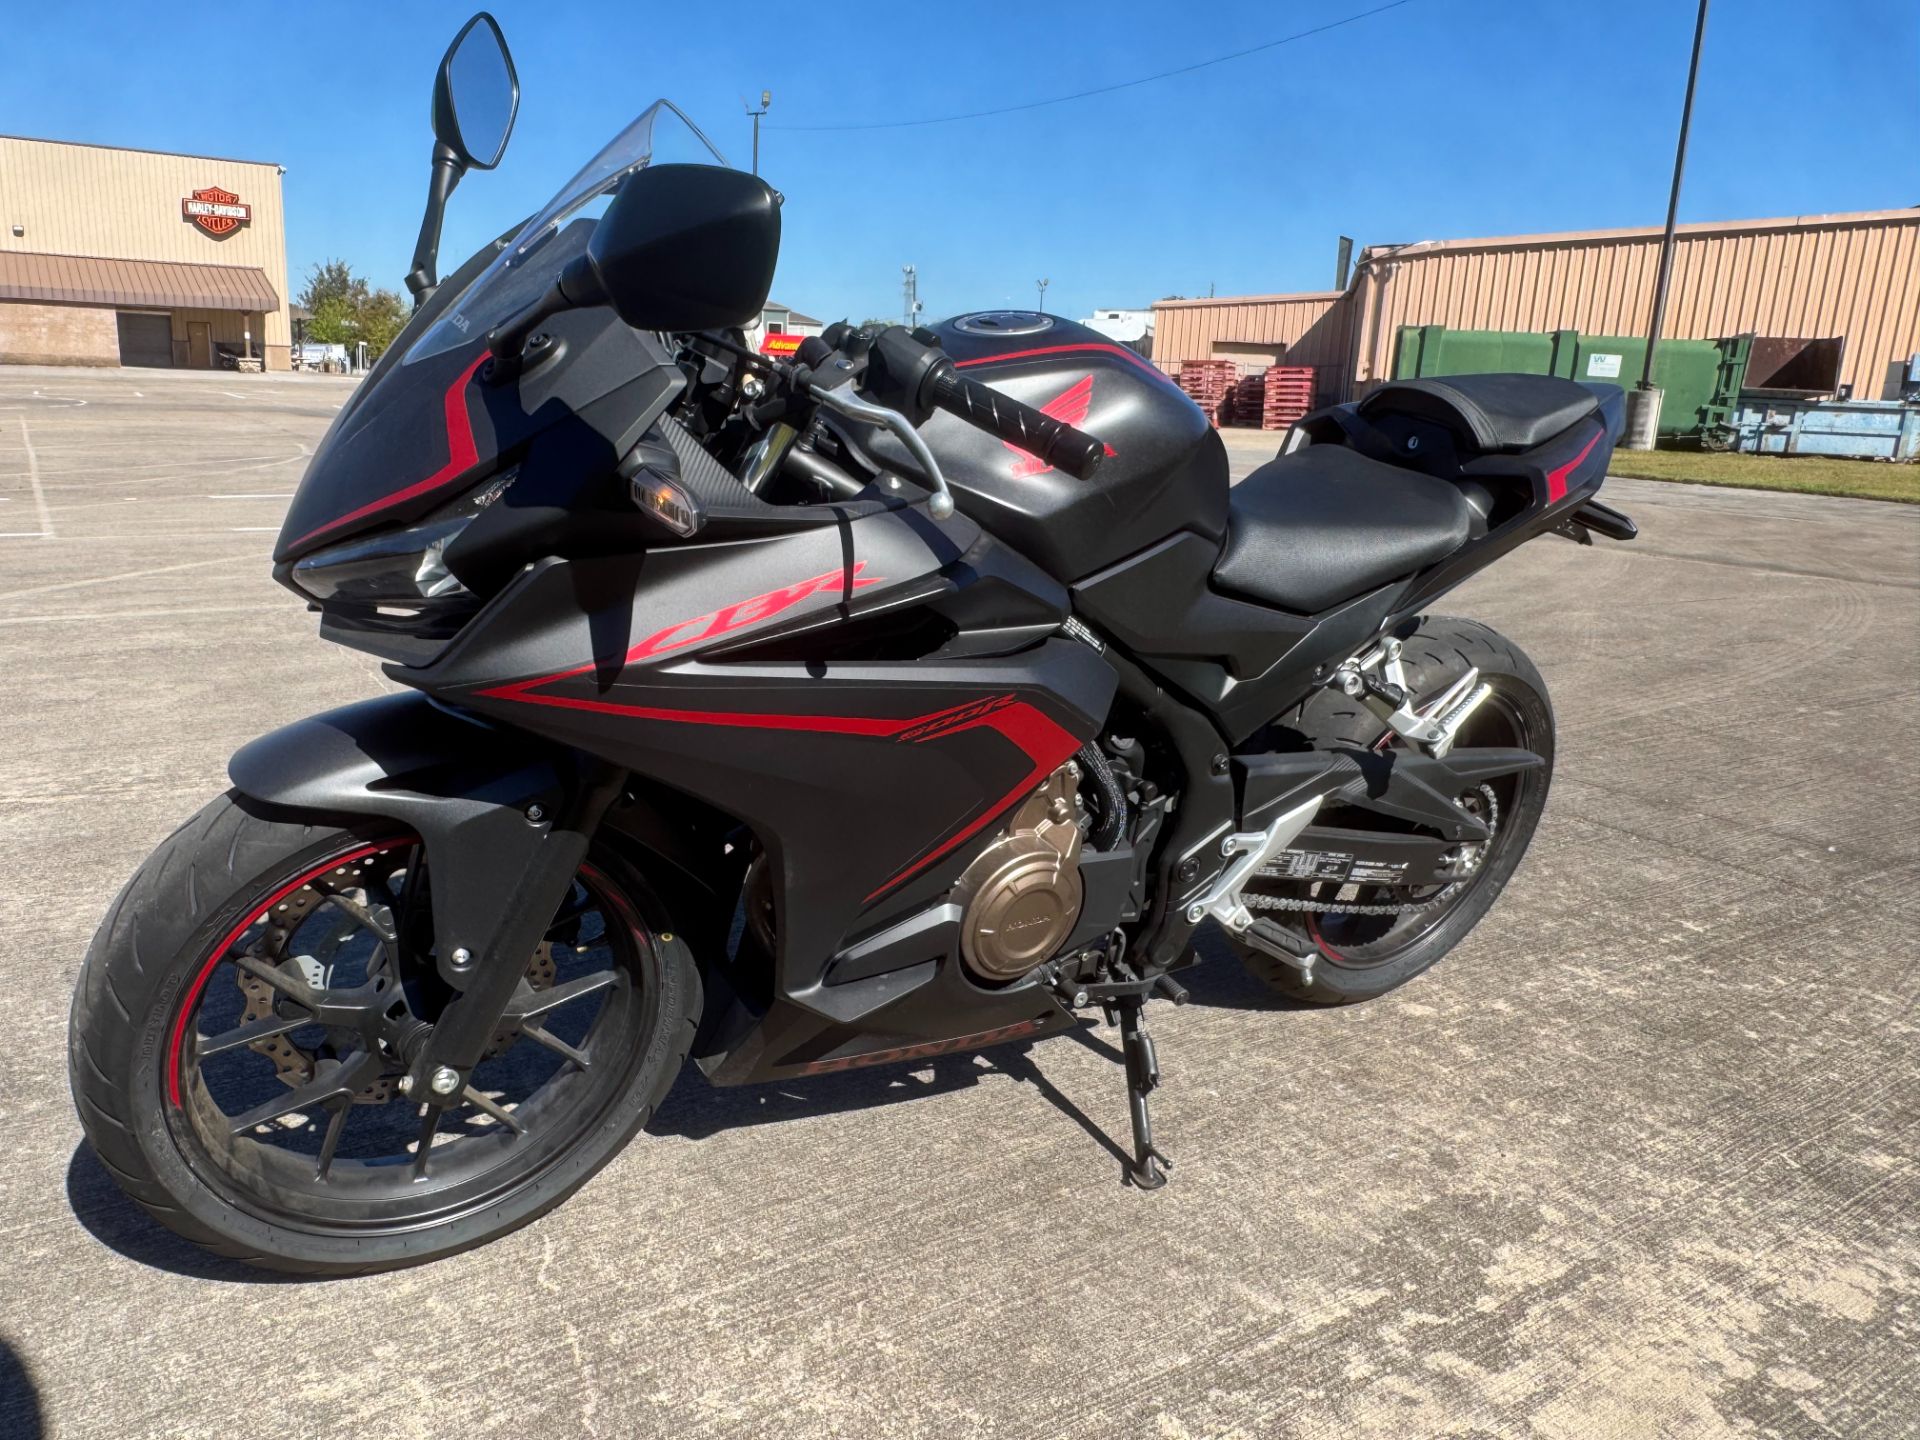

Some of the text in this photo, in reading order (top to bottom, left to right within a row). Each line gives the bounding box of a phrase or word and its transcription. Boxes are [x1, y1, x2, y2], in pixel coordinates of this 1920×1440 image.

[200, 192, 235, 204] MOTOR
[188, 201, 247, 218] HARLEY-DAVIDSON
[202, 216, 234, 231] CYCLES
[624, 559, 887, 665] CBR
